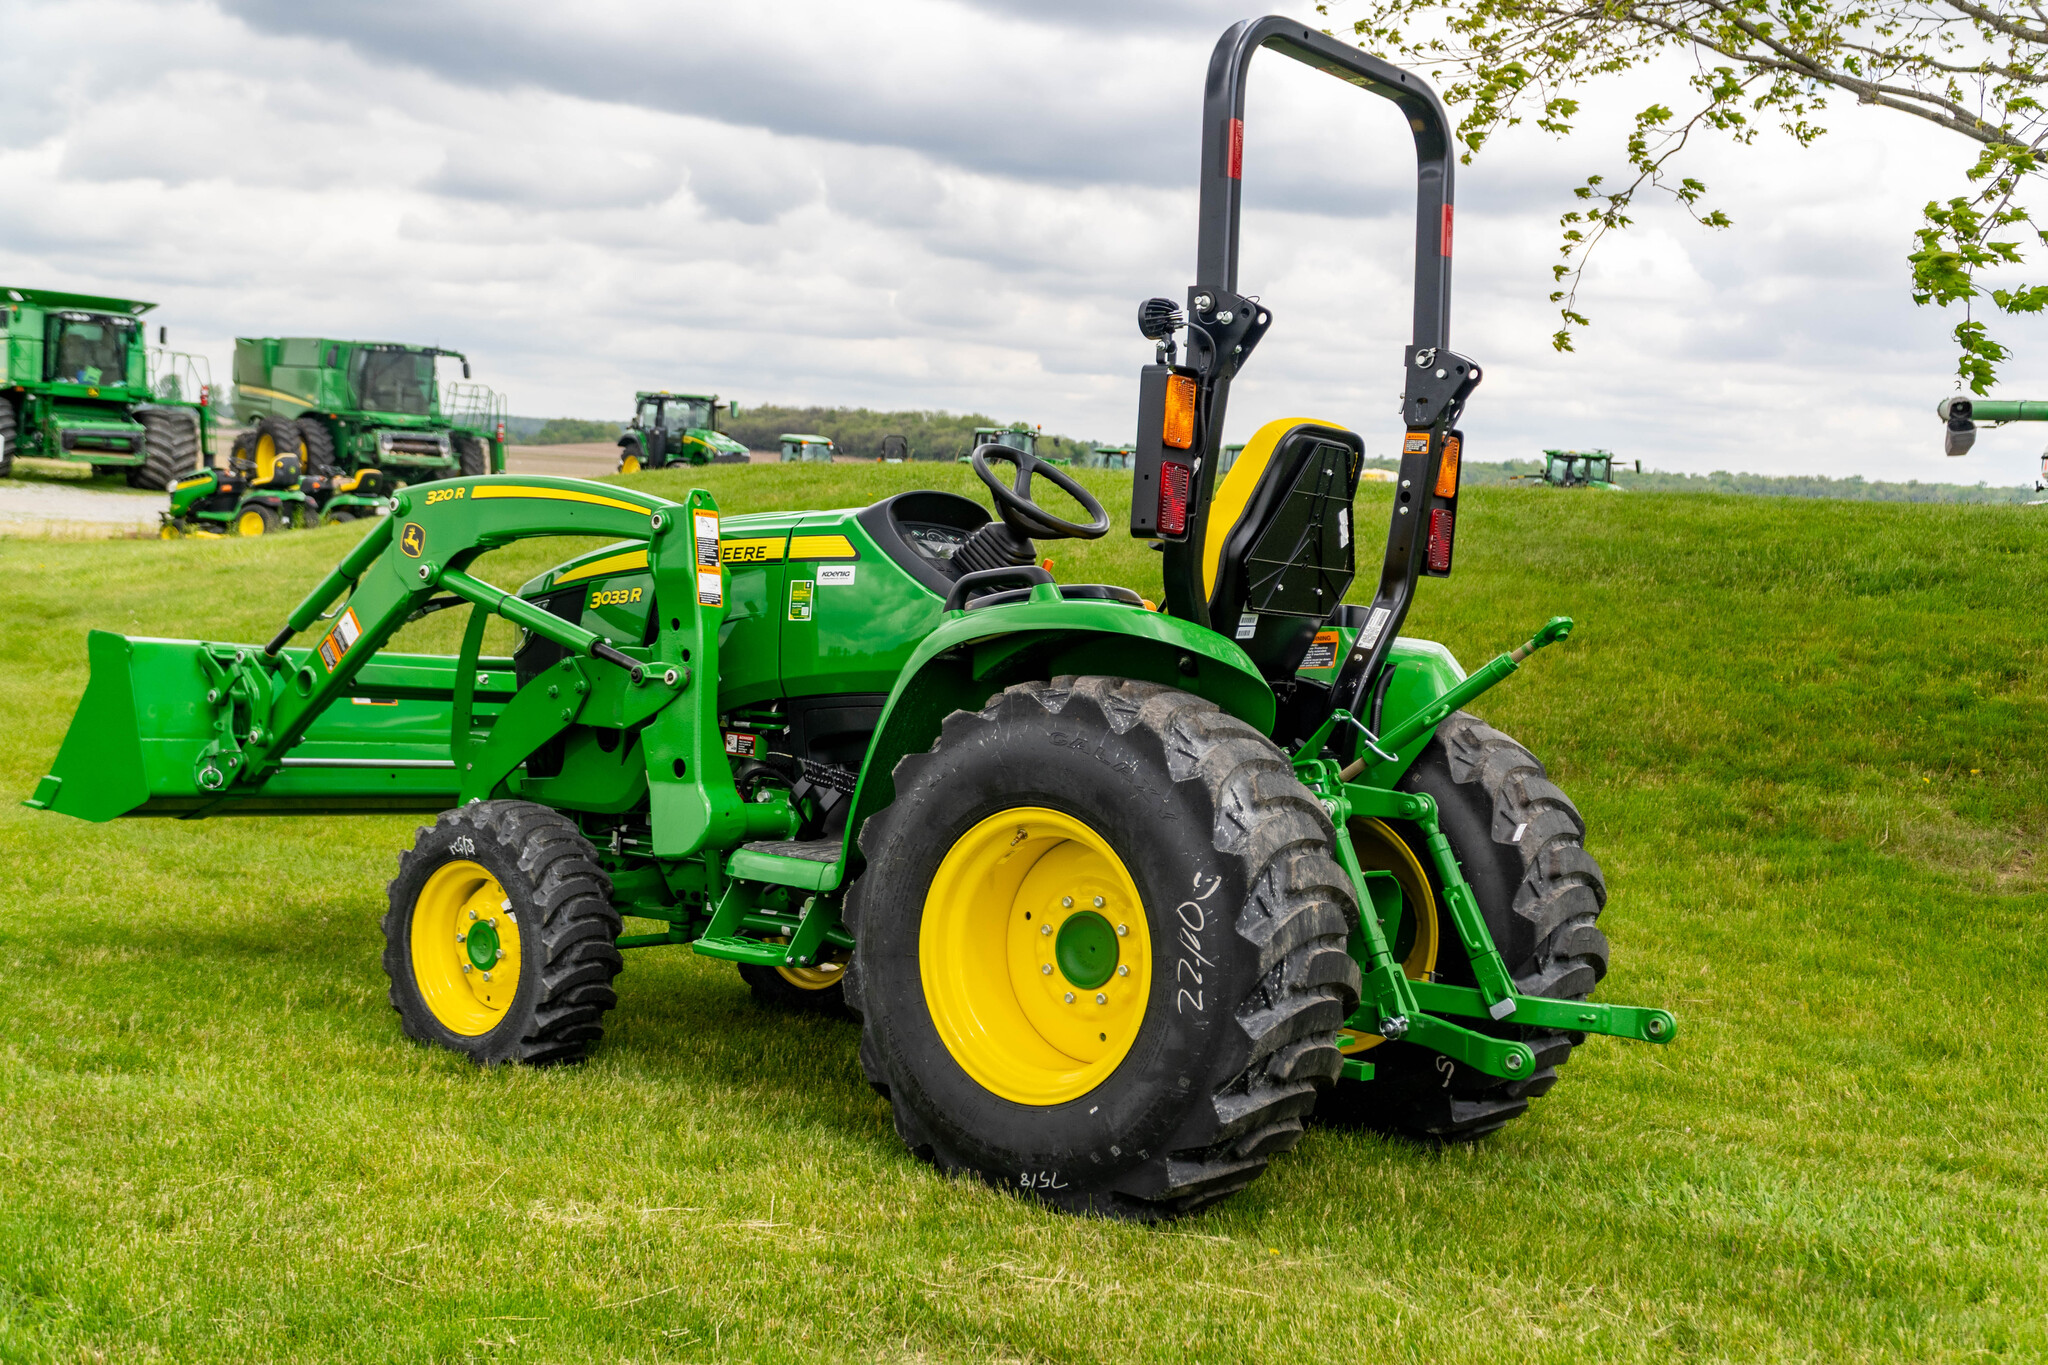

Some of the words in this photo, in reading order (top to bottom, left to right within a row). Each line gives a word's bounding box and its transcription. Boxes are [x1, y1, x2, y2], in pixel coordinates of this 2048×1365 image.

[425, 488, 454, 505] 320
[454, 486, 466, 500] R
[720, 546, 767, 560] EERE
[590, 589, 629, 609] 3033
[630, 587, 643, 602] R
